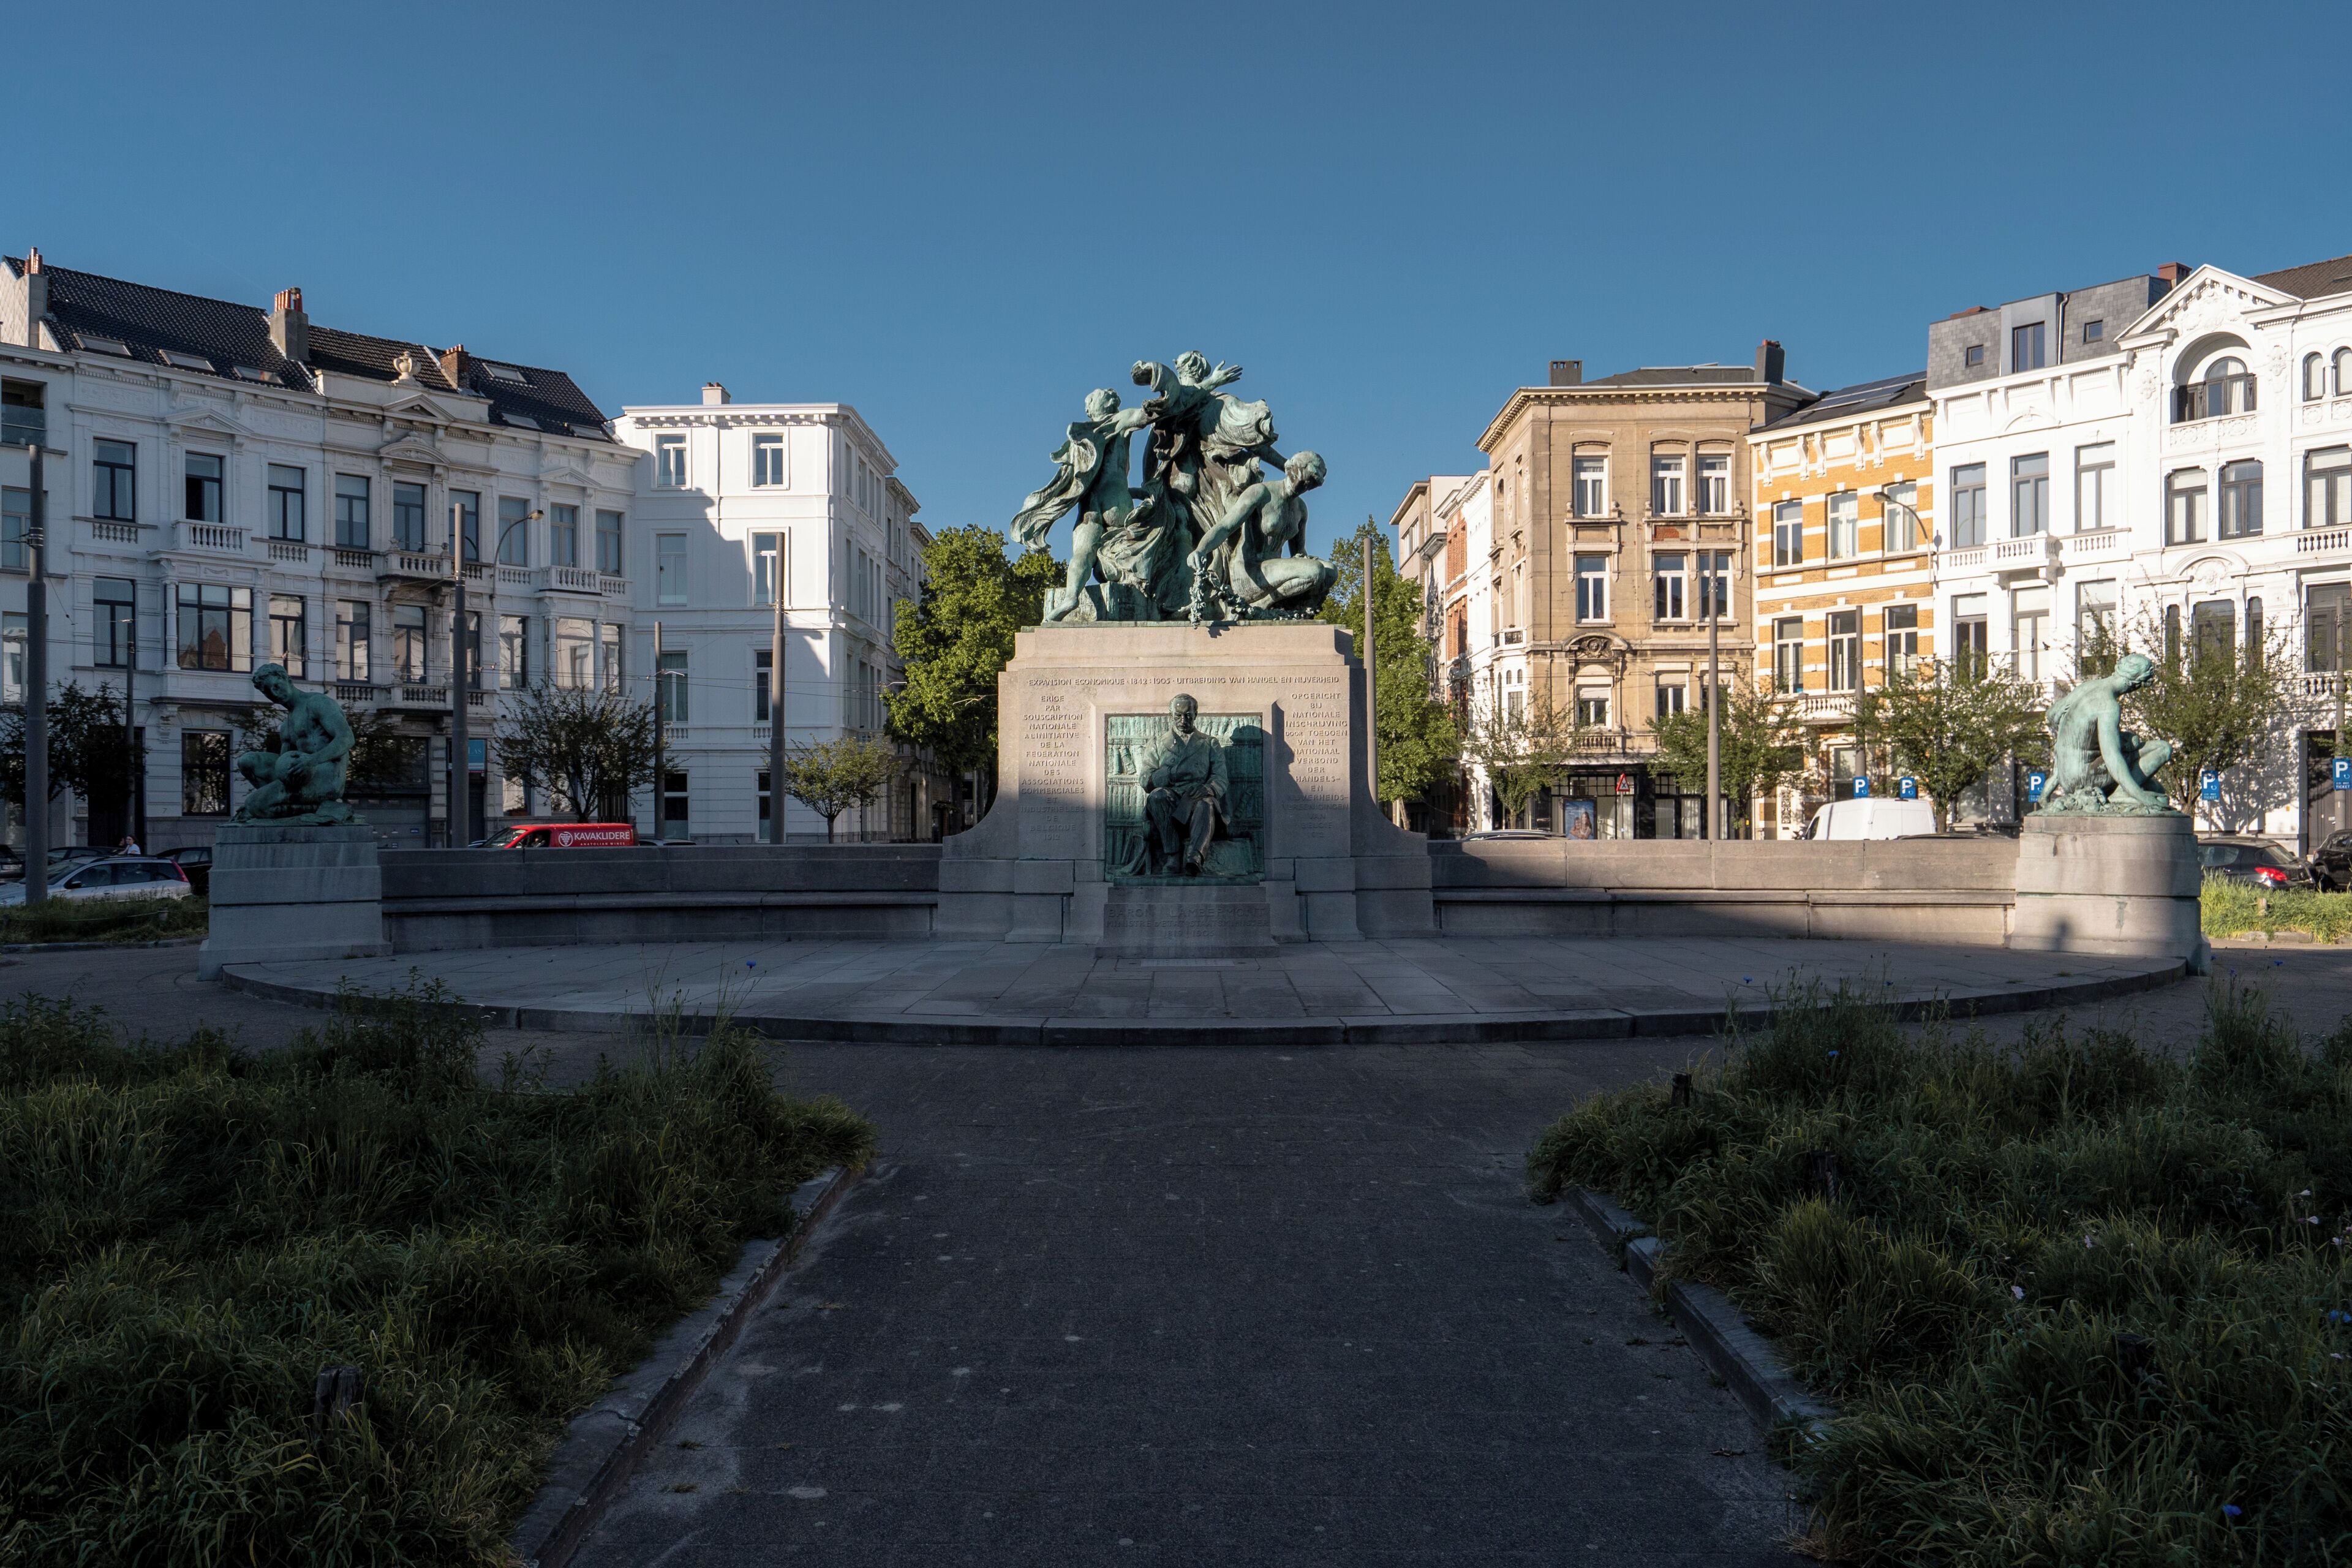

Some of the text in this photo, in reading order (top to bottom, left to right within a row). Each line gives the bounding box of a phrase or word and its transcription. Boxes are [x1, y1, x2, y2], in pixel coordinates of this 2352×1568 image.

[2335, 762, 2348, 778] P
[1855, 779, 1866, 793] P
[1902, 780, 1913, 794] P
[2030, 775, 2042, 791] P
[2204, 774, 2215, 789] P
[575, 832, 630, 840] KAVAKLIDERE
[1108, 908, 1155, 918] BARON
